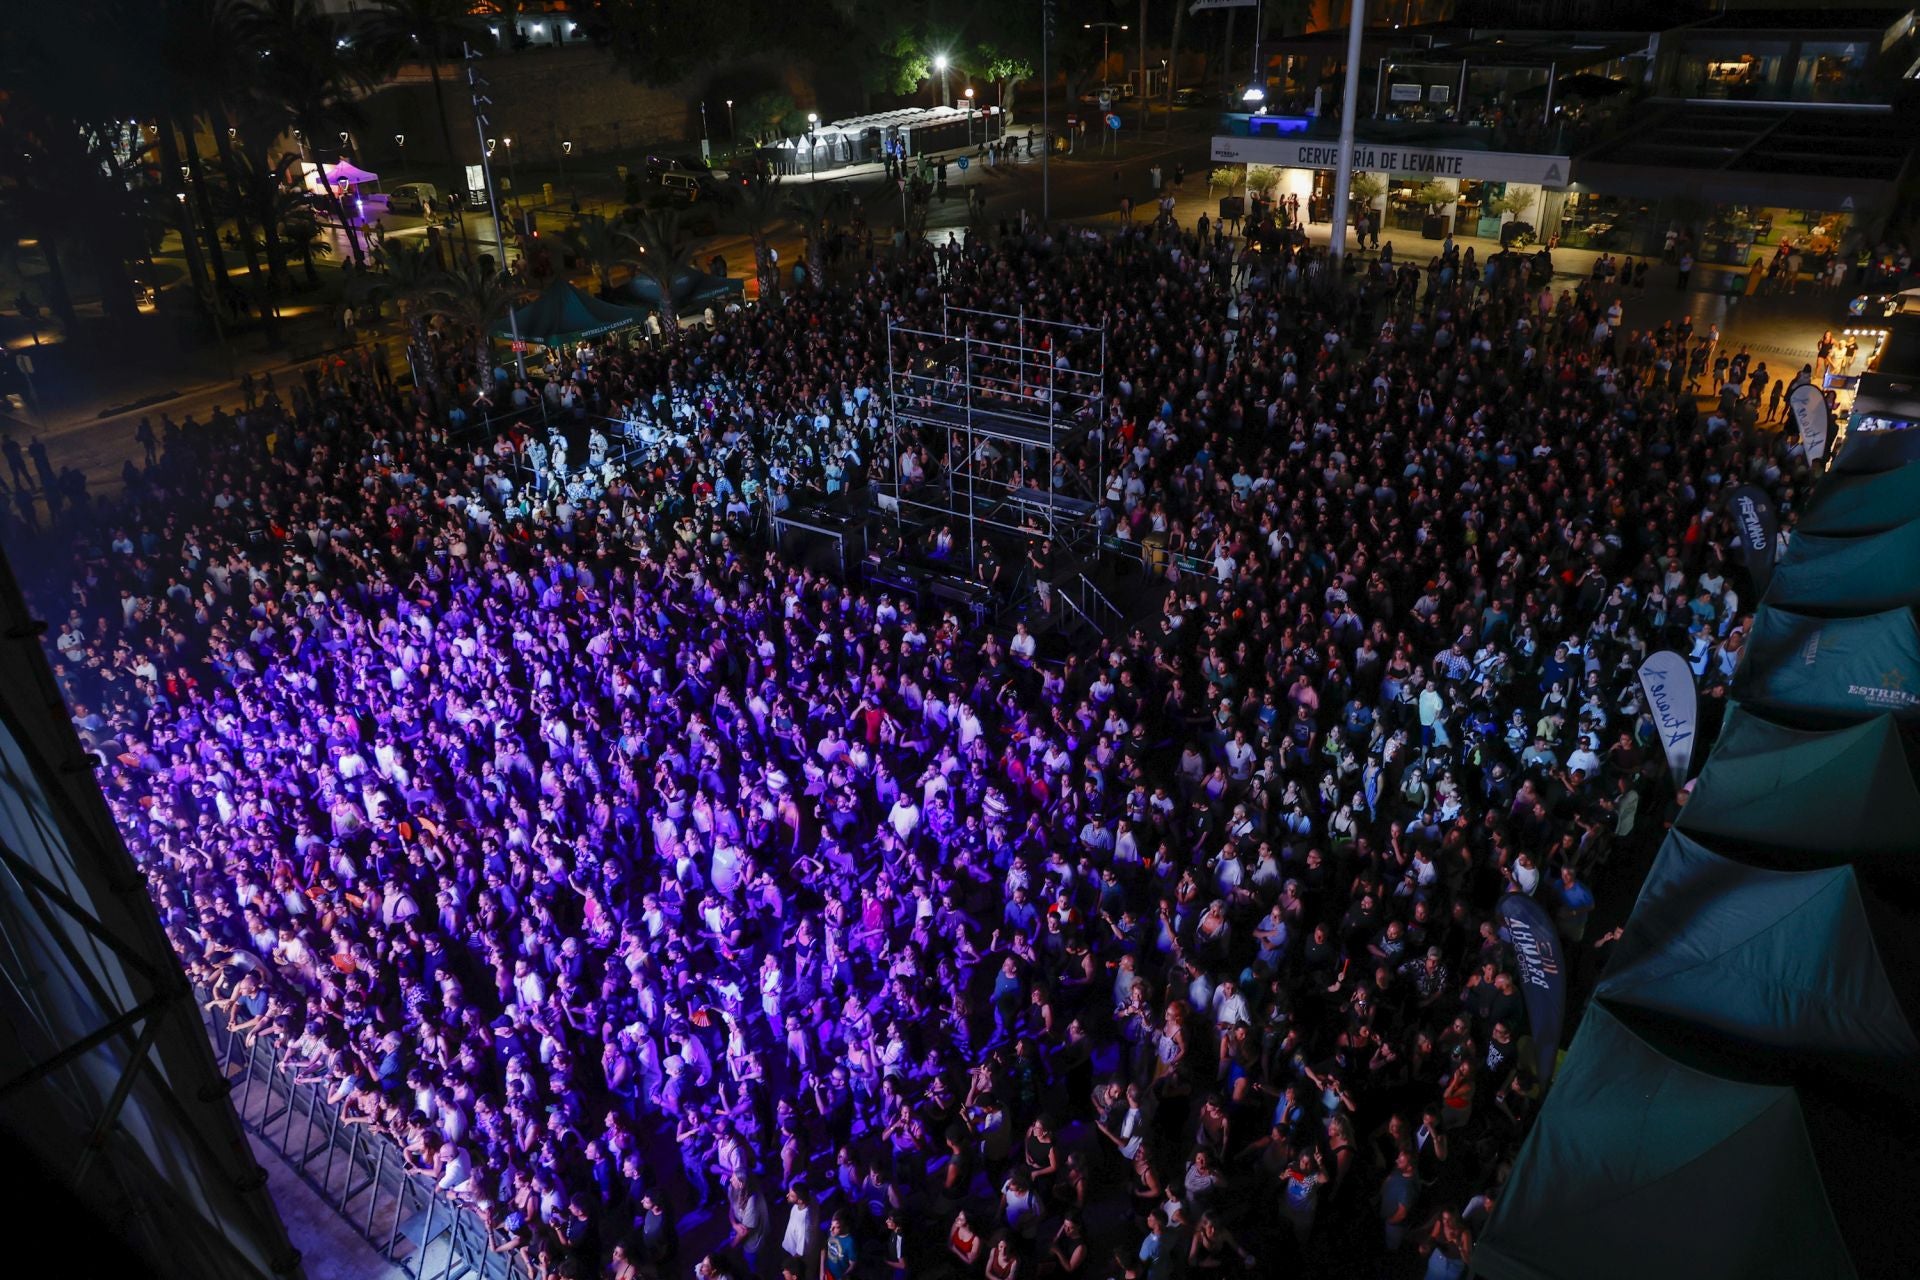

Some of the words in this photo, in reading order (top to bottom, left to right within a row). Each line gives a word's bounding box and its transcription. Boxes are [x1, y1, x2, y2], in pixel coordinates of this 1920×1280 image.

[1298, 146, 1375, 169] CERVERÍA
[1380, 152, 1397, 170] DE
[1402, 153, 1463, 174] LEVANTE
[1847, 685, 1920, 704] ESTRELL
